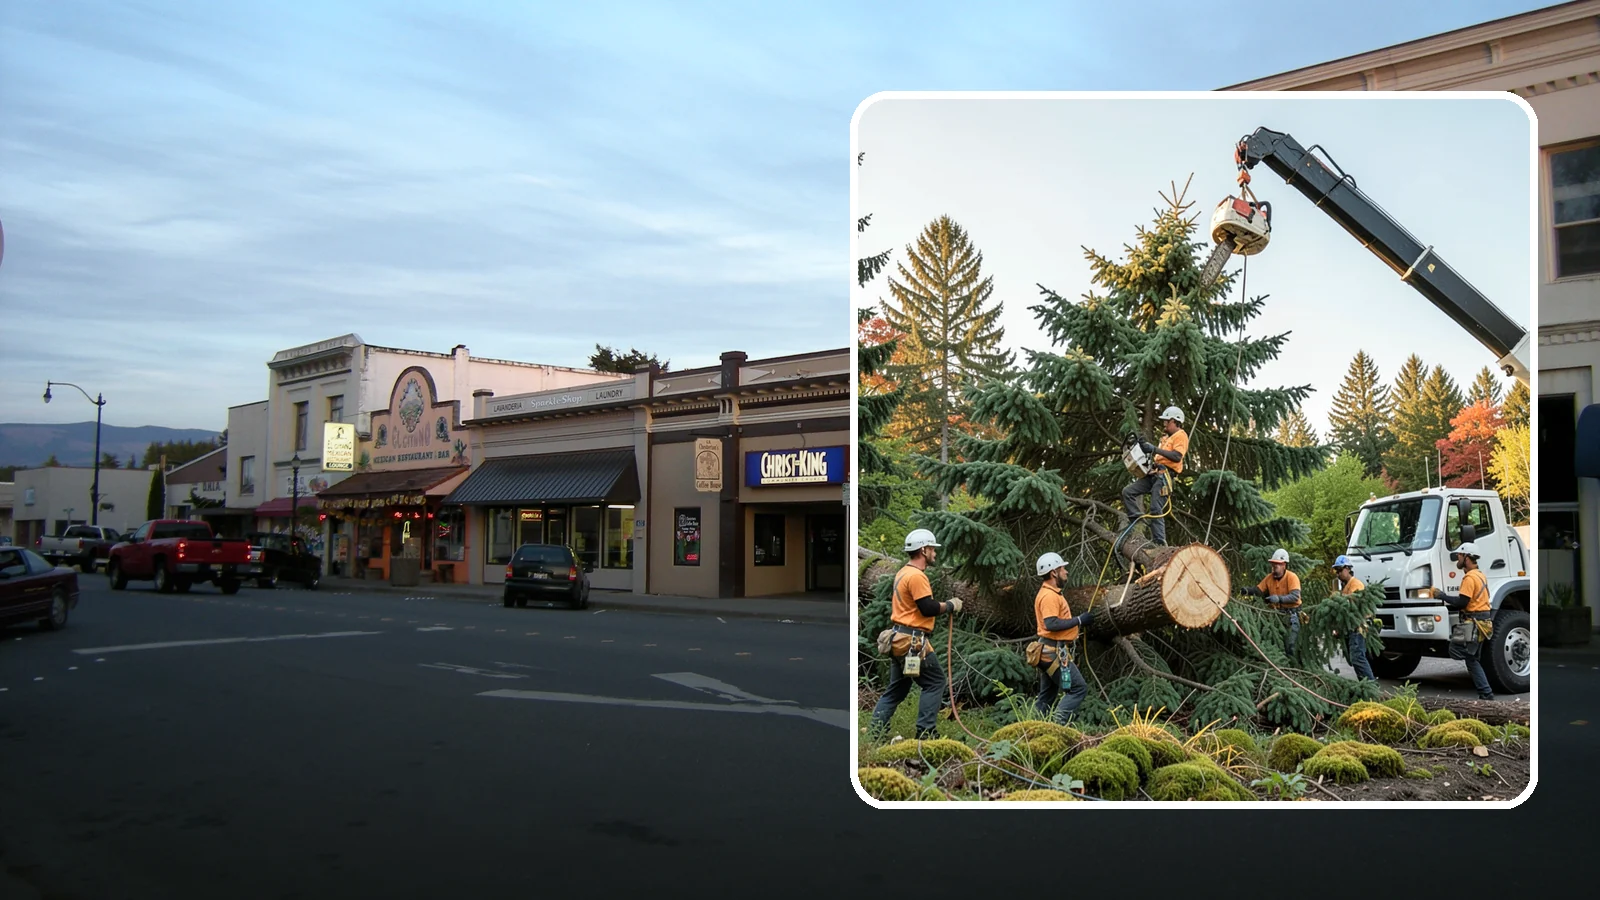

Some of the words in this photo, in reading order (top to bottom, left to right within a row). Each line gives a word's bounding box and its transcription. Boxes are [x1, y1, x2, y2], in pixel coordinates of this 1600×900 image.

[595, 388, 623, 400] LAUNDRY
[493, 402, 522, 412] LAVANDERIA
[530, 396, 560, 409] Sparkle
[561, 394, 583, 406] Shop
[373, 454, 396, 464] MEXICAN
[397, 451, 434, 462] RESTAURANT
[437, 450, 450, 459] BAR
[760, 452, 797, 478] CHRIST
[799, 450, 827, 476] KING
[696, 480, 709, 488] Coffee
[709, 480, 722, 488] House
